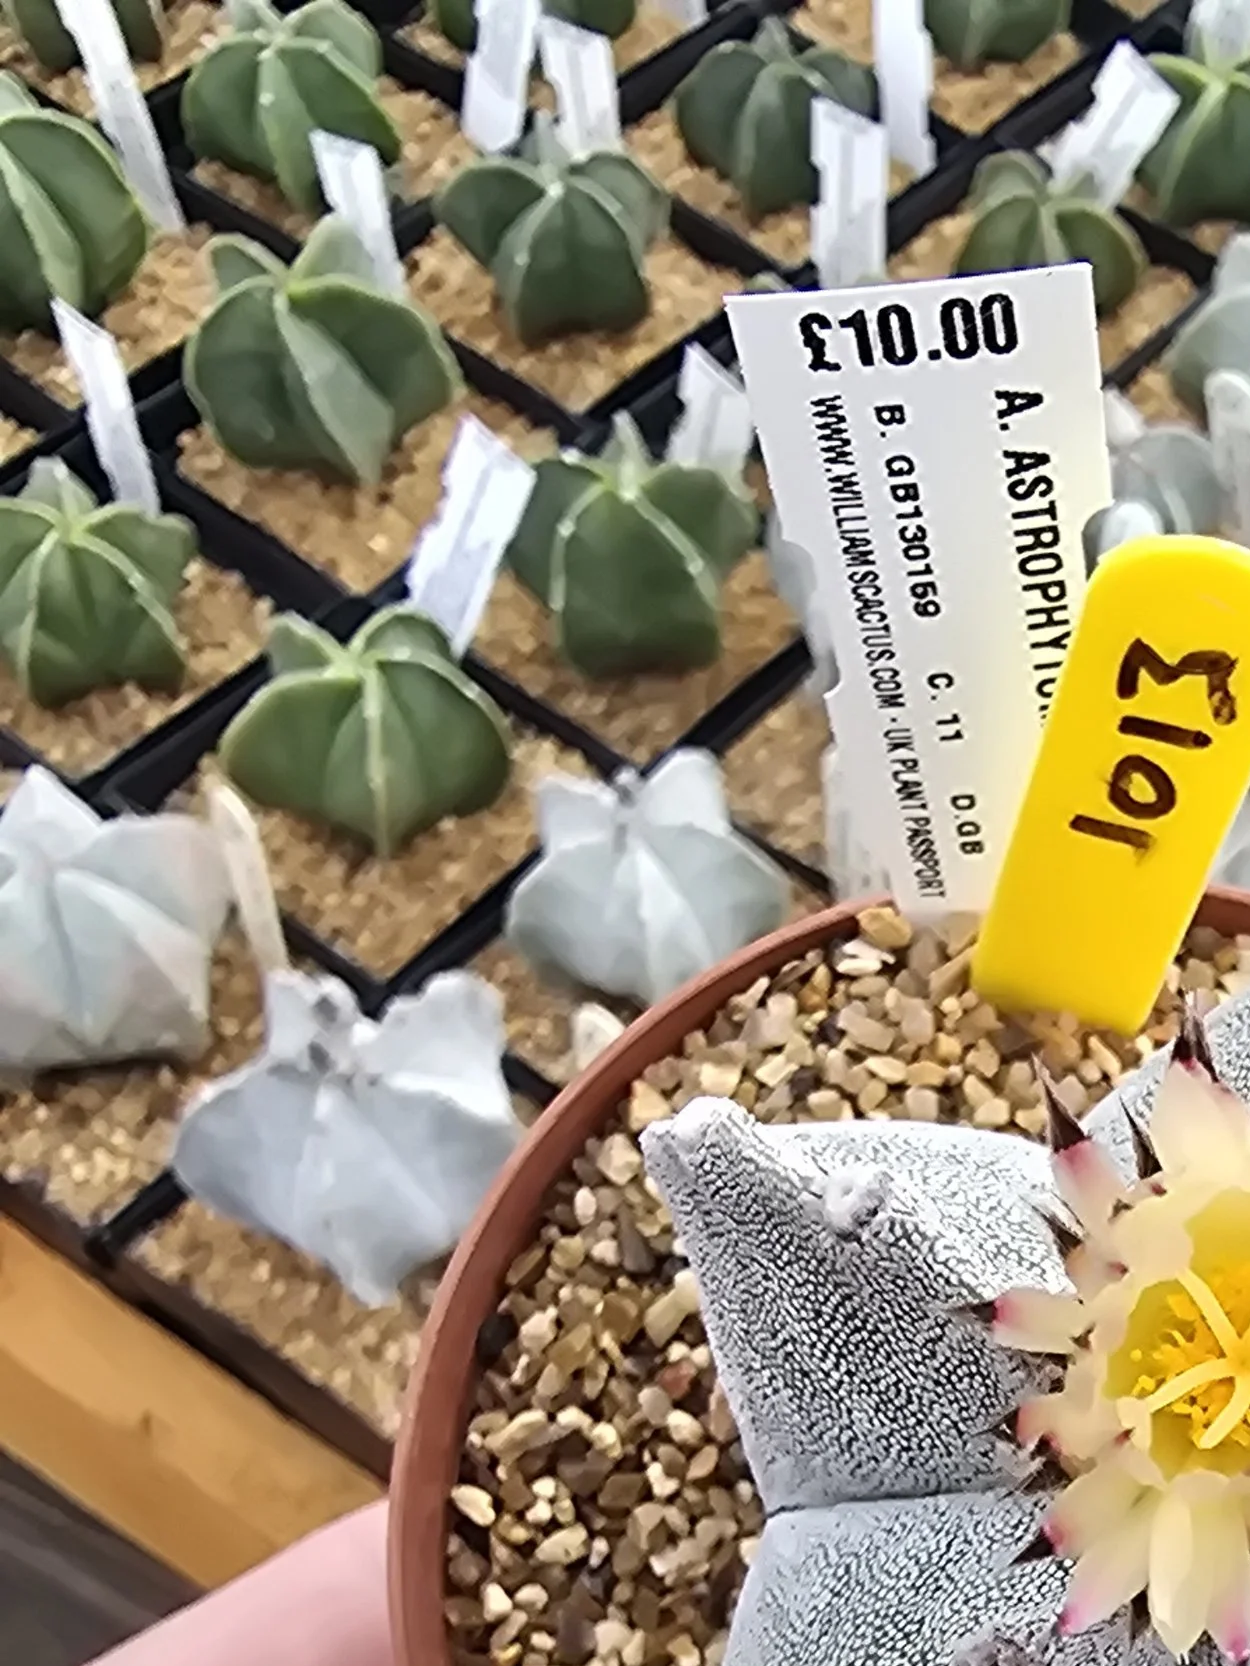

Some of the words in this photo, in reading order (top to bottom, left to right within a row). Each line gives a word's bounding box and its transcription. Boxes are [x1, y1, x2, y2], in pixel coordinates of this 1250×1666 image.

[799, 292, 1019, 372] £10.00
[873, 403, 907, 438] B.
[994, 389, 1044, 432] A.
[809, 394, 906, 709] WWW.WILLIAMSCACTUS.COM
[1001, 449, 1073, 728] ASTROPHY
[926, 672, 955, 702] C.
[882, 727, 916, 754] UK
[935, 712, 964, 742] 11
[890, 757, 929, 811] PLANT
[903, 815, 947, 899] PASSPORT
